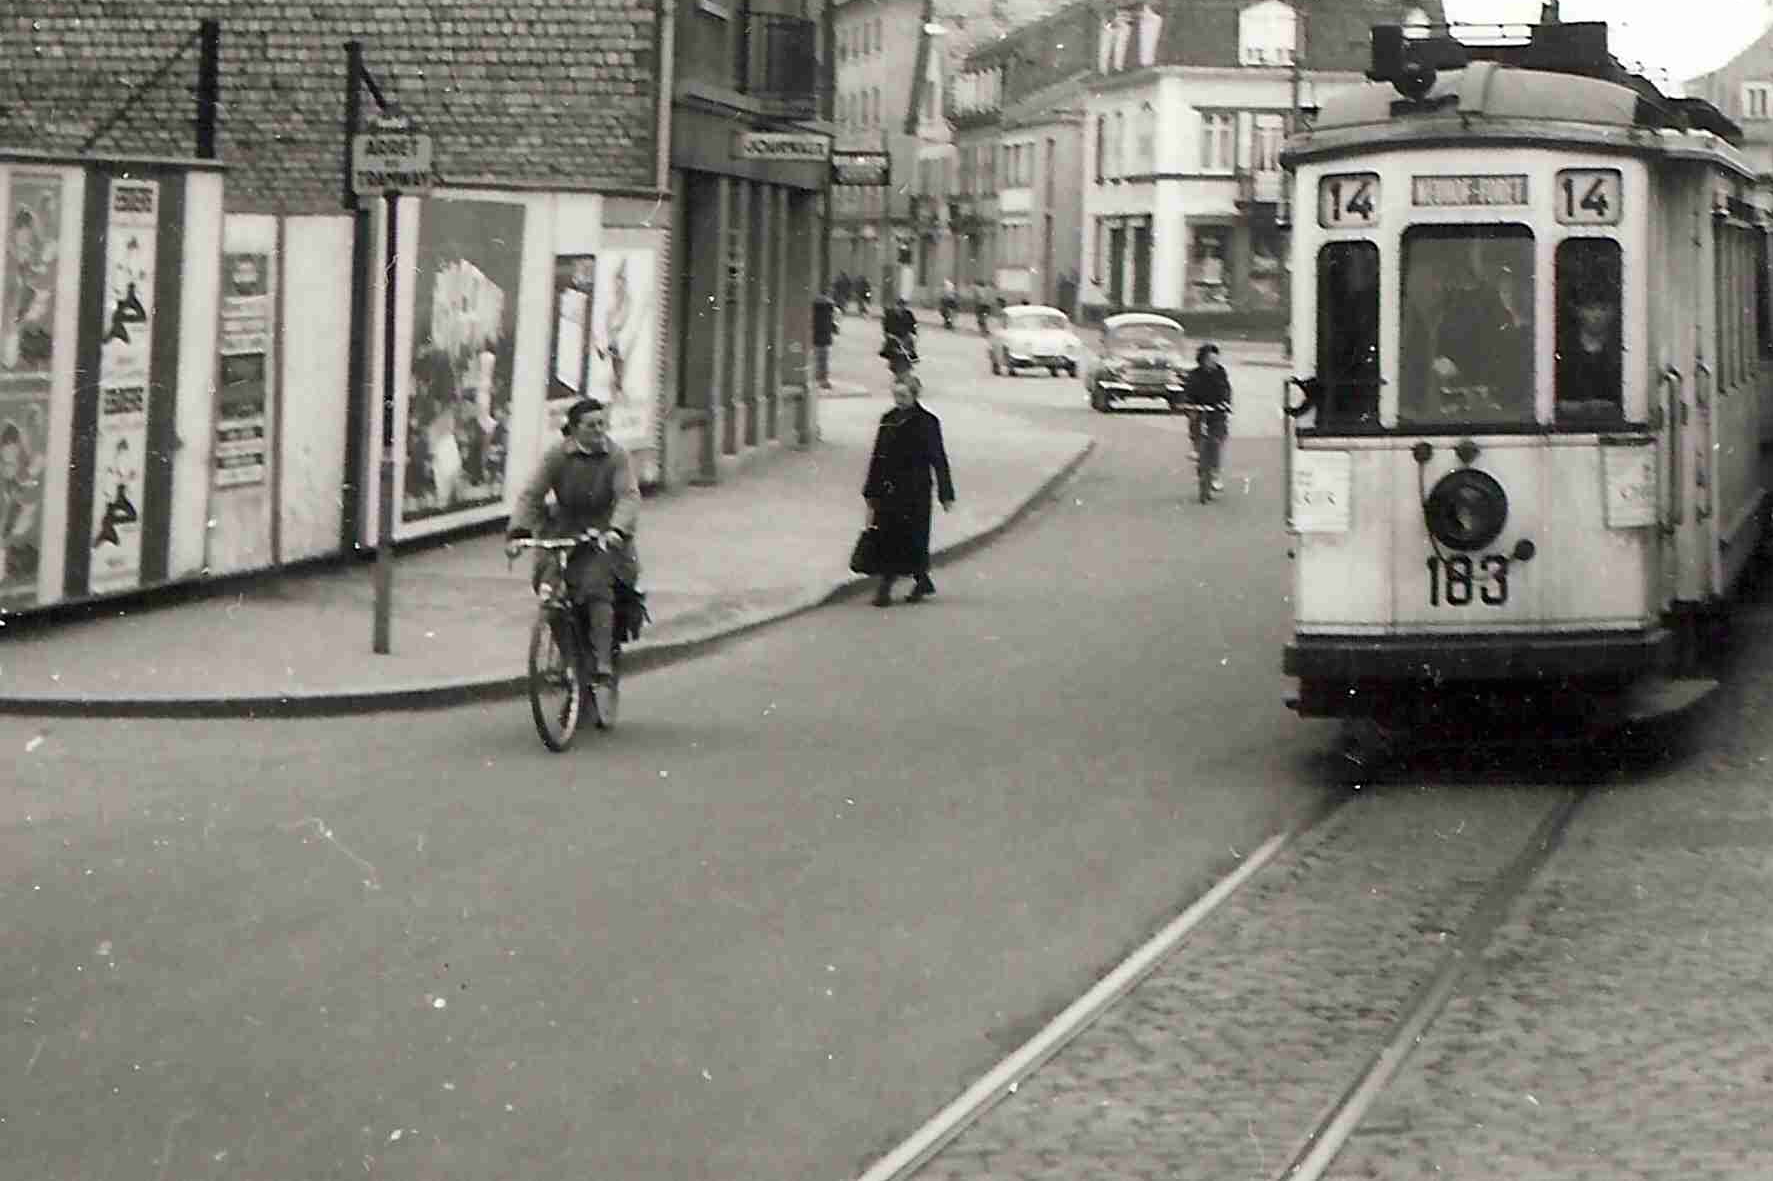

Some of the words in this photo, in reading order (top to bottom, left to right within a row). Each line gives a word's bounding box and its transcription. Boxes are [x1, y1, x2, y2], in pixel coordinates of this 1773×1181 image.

[1330, 178, 1374, 221] 14
[1562, 176, 1610, 218] 14
[1426, 553, 1508, 607] 183
